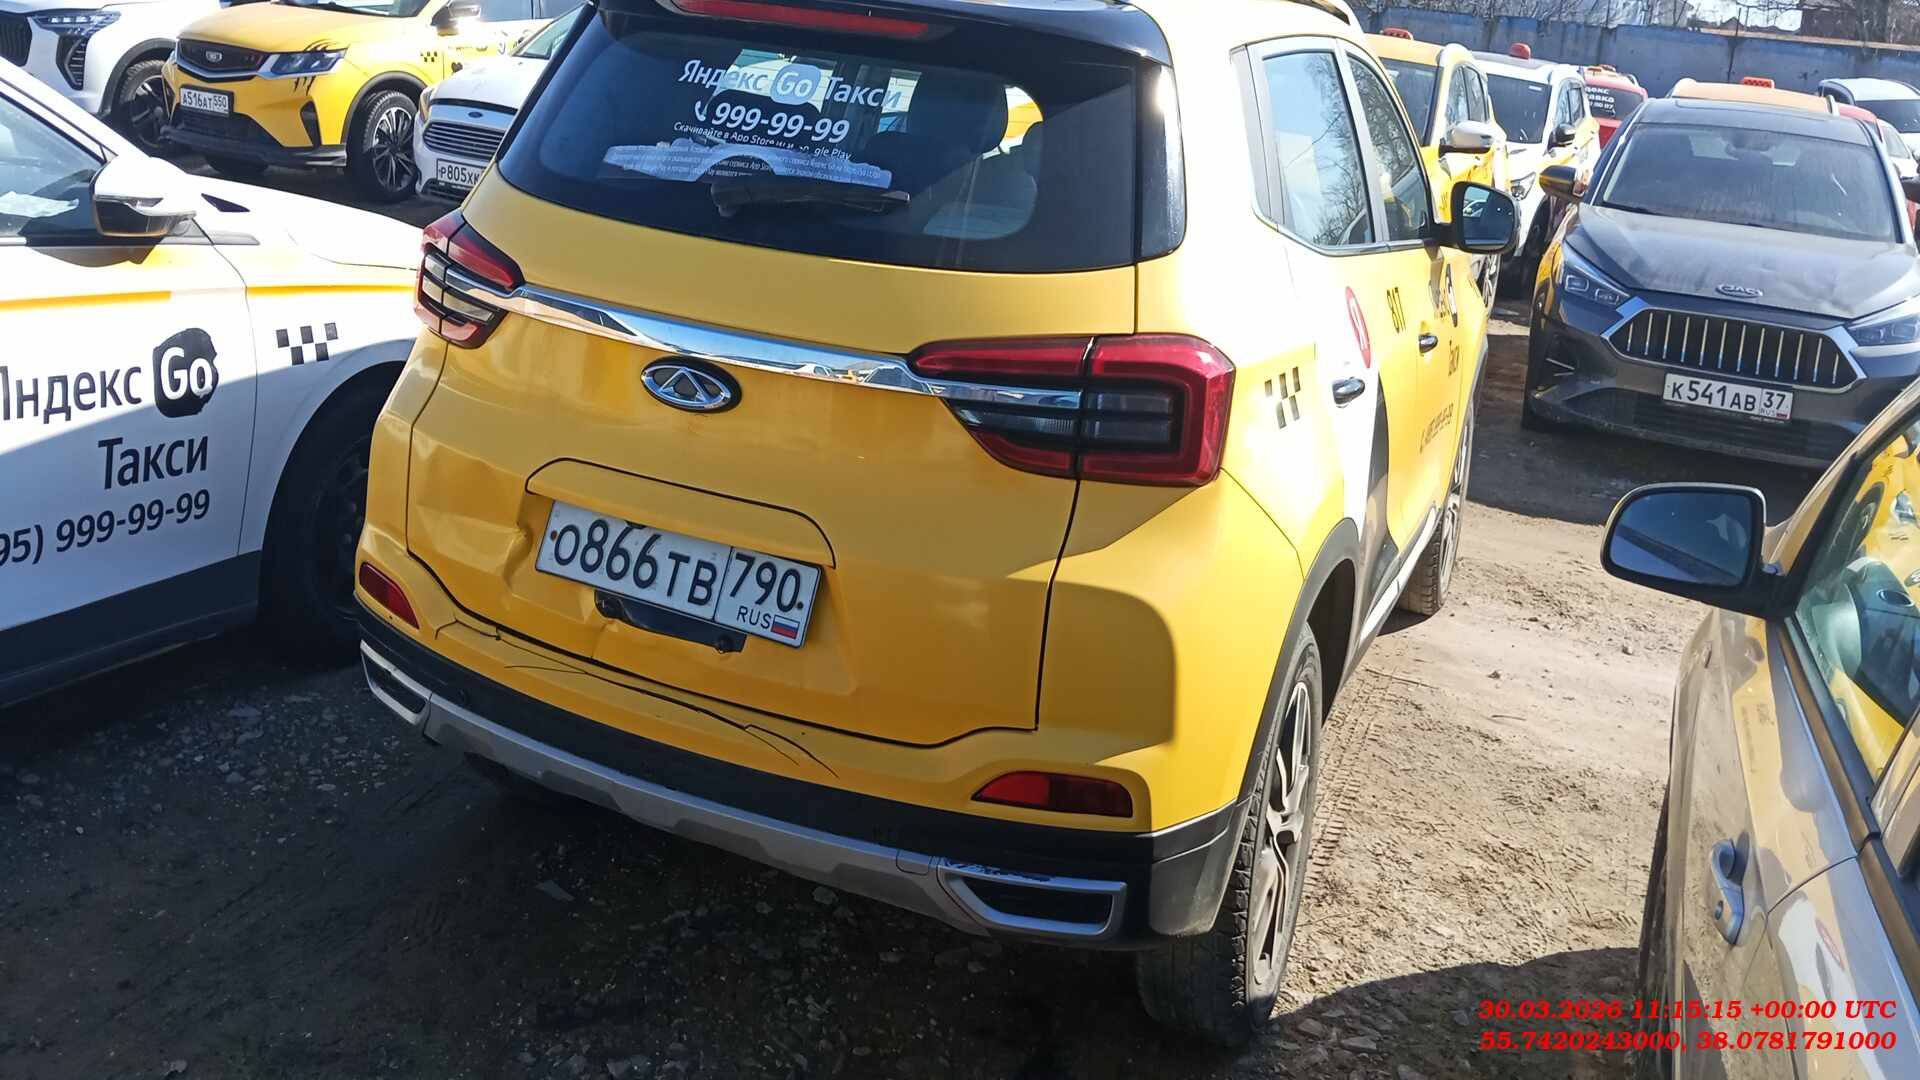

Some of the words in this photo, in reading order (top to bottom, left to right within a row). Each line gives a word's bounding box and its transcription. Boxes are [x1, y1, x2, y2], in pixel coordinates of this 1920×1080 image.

[678, 59, 768, 91] Яндекс
[775, 73, 812, 98] Go
[824, 77, 905, 107] Такси
[673, 121, 723, 139] Скачивайте
[711, 101, 850, 144] 999-99-99
[160, 346, 213, 400] Go
[1671, 380, 1757, 412] К541АВ
[1763, 391, 1786, 410] 37
[98, 435, 208, 490] Такси
[56, 488, 210, 552] 999-99-99
[553, 518, 718, 606] О866ТВ
[730, 552, 801, 613] 790
[736, 605, 772, 630] RUS
